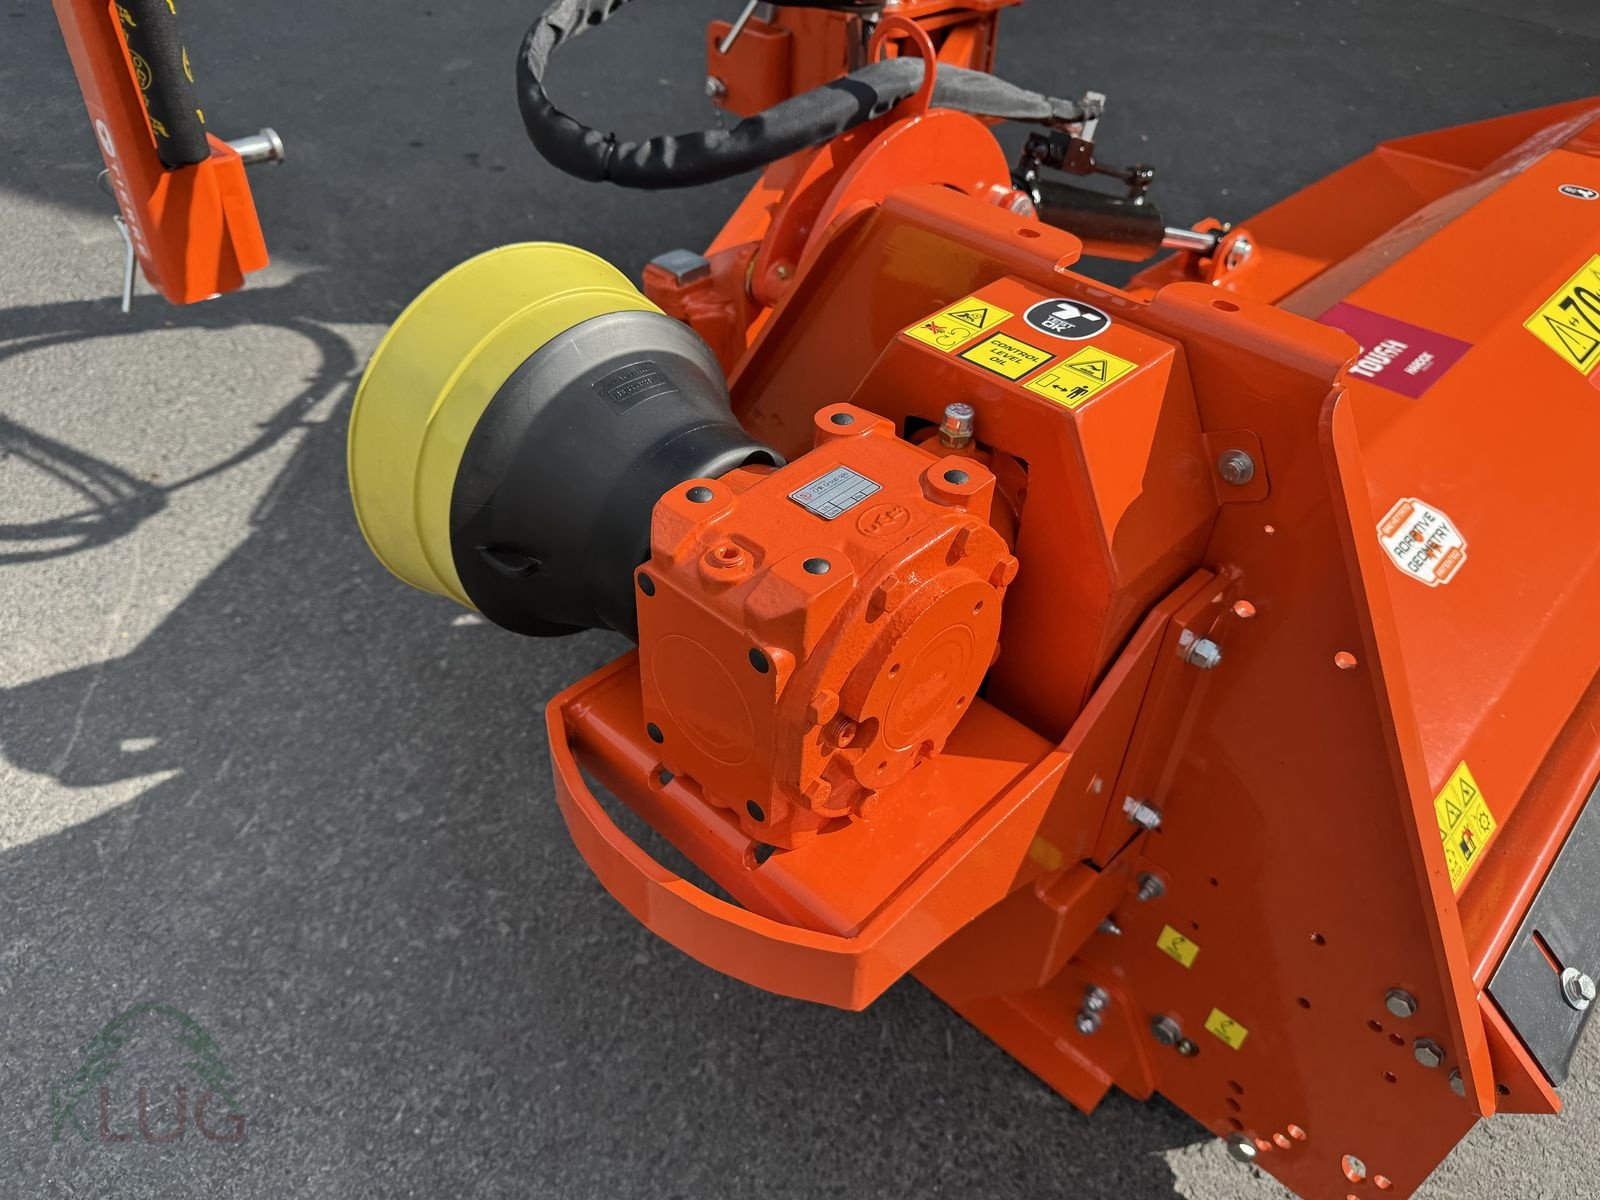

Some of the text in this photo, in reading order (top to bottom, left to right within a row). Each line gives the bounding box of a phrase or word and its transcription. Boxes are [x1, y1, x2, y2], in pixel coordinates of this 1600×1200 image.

[1041, 320, 1066, 333] OK
[1047, 314, 1076, 329] TEST
[990, 339, 1040, 363] CONTROL
[990, 348, 1022, 365] LEVEL
[1348, 339, 1409, 378] TOUGH
[989, 356, 1006, 367] OIL
[1393, 511, 1436, 559] ADAPTIVE
[1407, 521, 1450, 573] GEOMETRY
